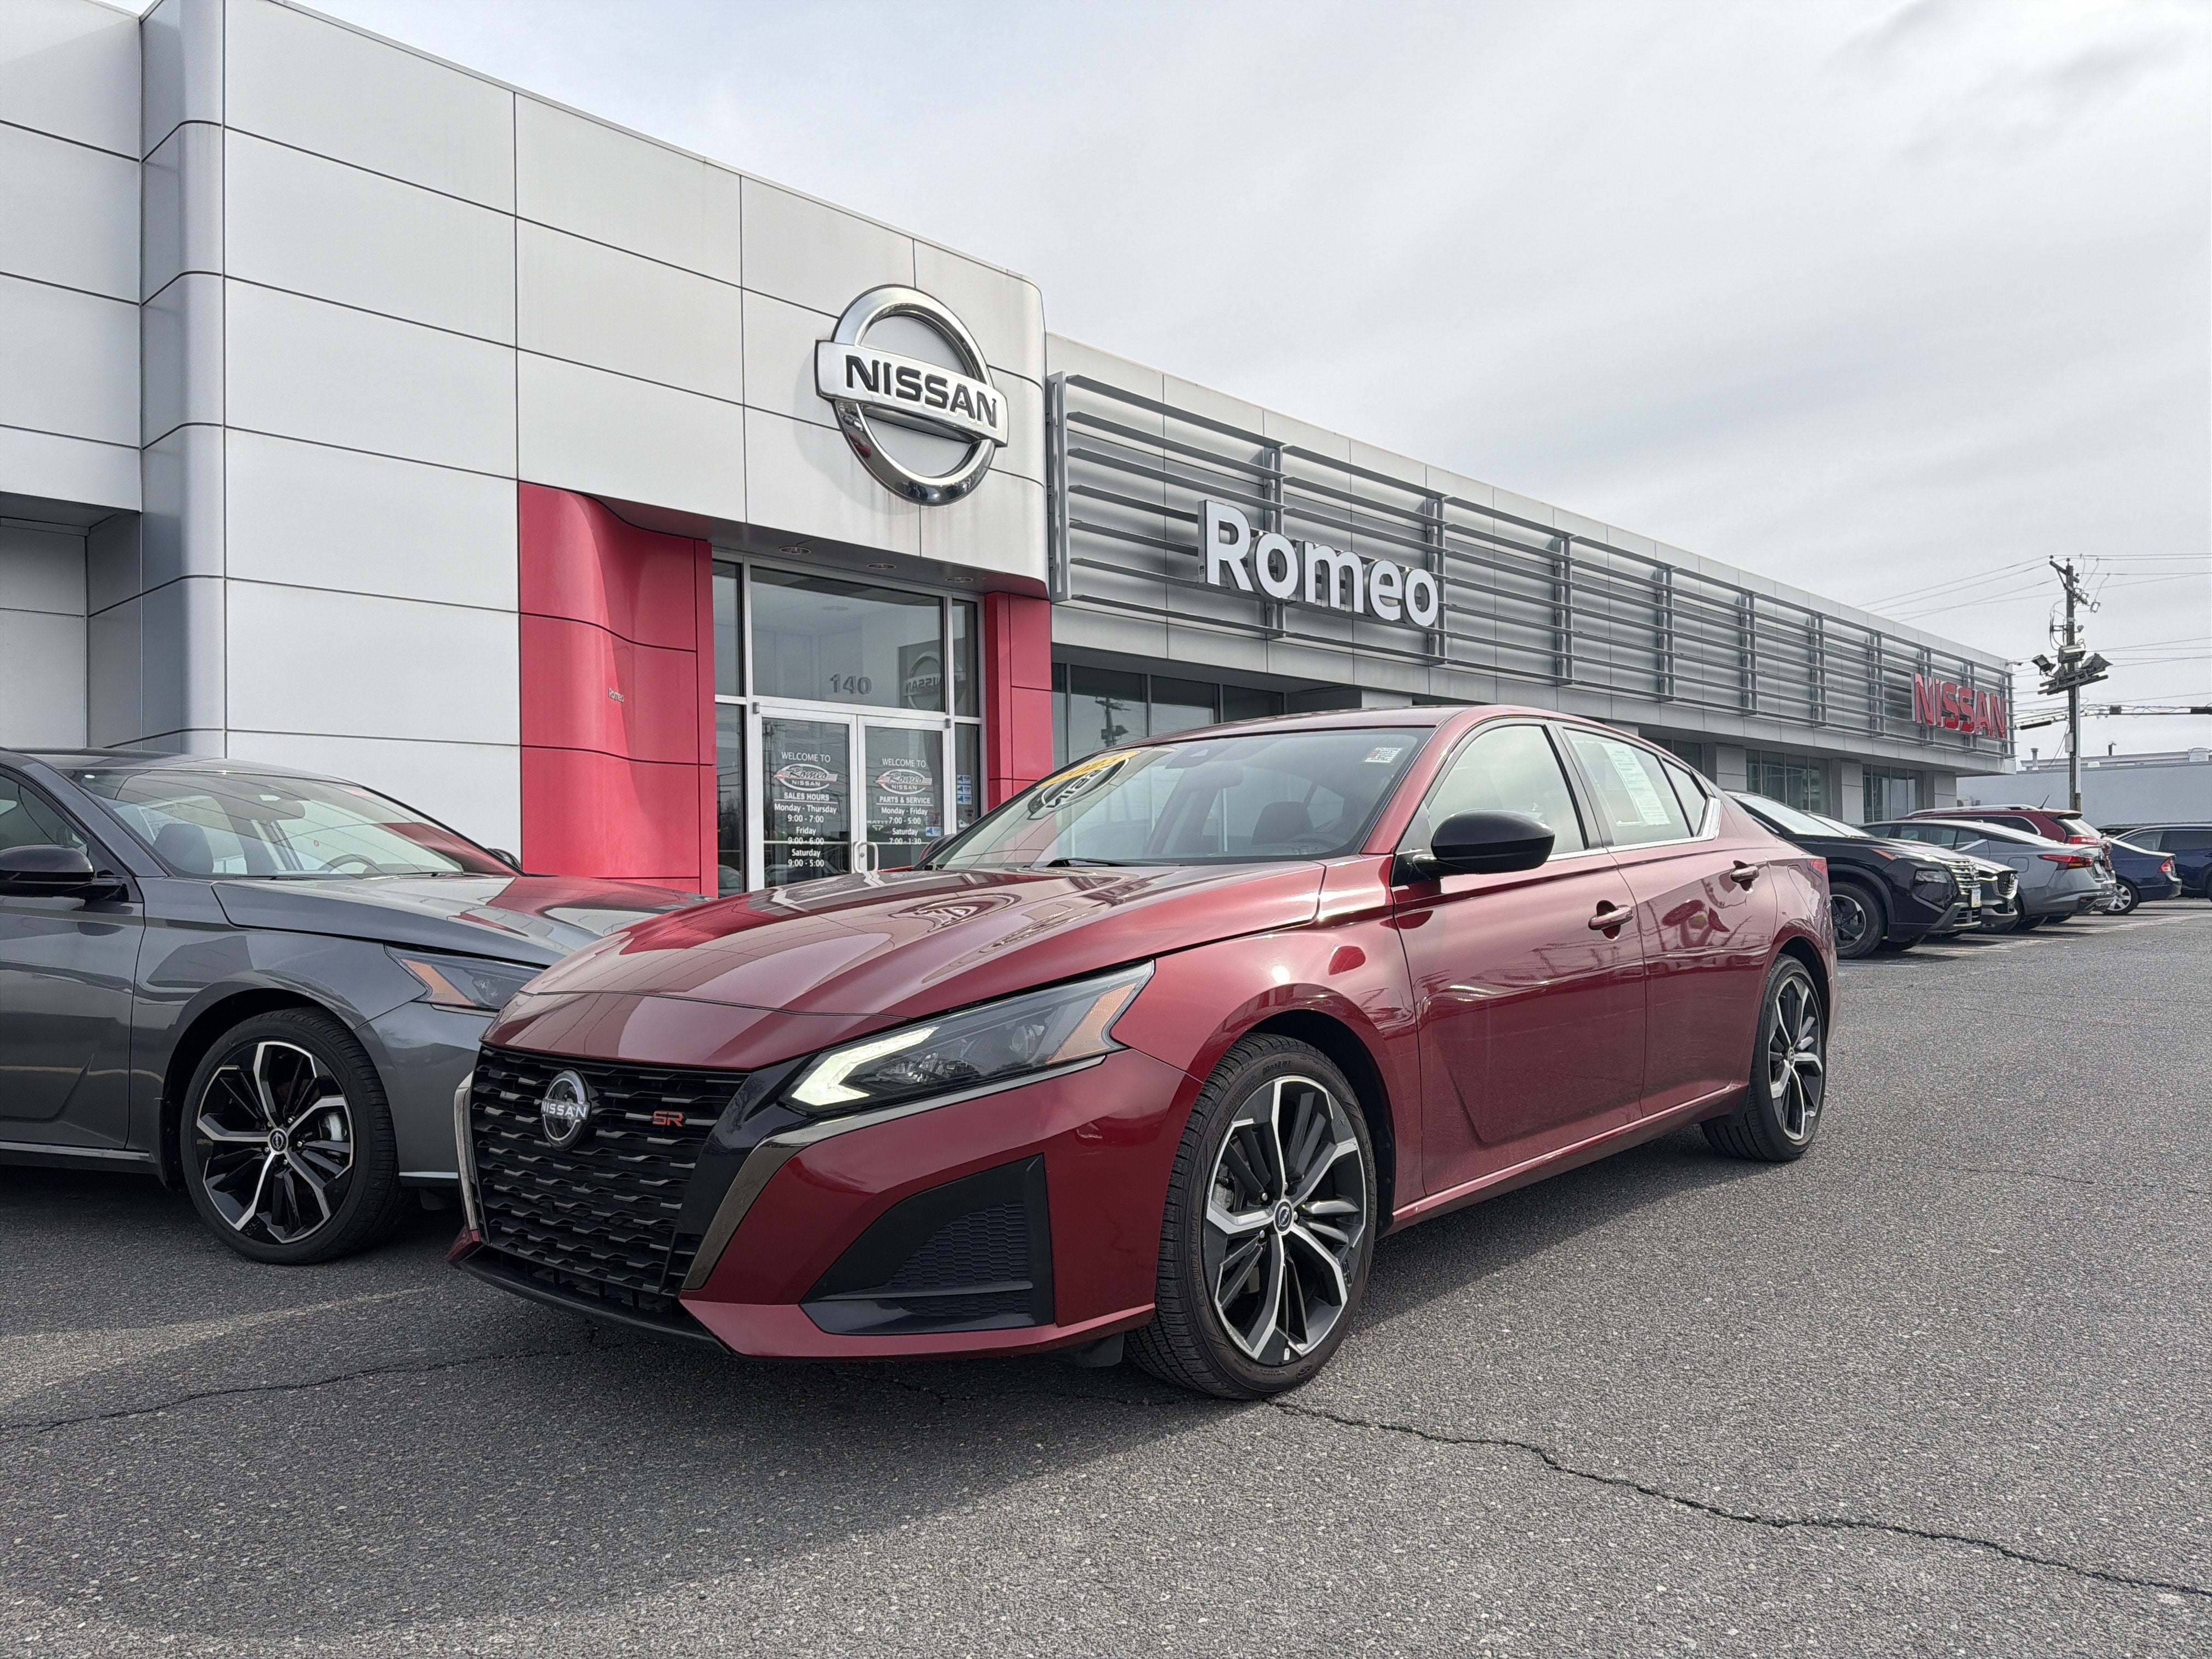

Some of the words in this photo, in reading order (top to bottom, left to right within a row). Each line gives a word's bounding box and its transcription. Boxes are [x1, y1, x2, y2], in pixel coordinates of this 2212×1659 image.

[845, 354, 997, 429] NISSAN
[1200, 499, 1438, 627] Romeo
[830, 674, 872, 695] 140
[608, 687, 624, 702] Romeo
[1914, 673, 2006, 739] NISSAN
[781, 752, 818, 762] WELCOME
[821, 754, 831, 763] TO
[882, 758, 915, 767] WELCOME
[787, 765, 827, 780] Romeo
[889, 771, 923, 783] Romeo
[774, 803, 801, 812] Monday
[806, 804, 837, 814] Thursday
[881, 807, 905, 815] Monday
[910, 808, 928, 816] Friday
[796, 826, 816, 836] Friday
[792, 849, 821, 858] Saturday
[541, 1101, 586, 1118] NISSAN
[653, 1111, 684, 1126] SR
